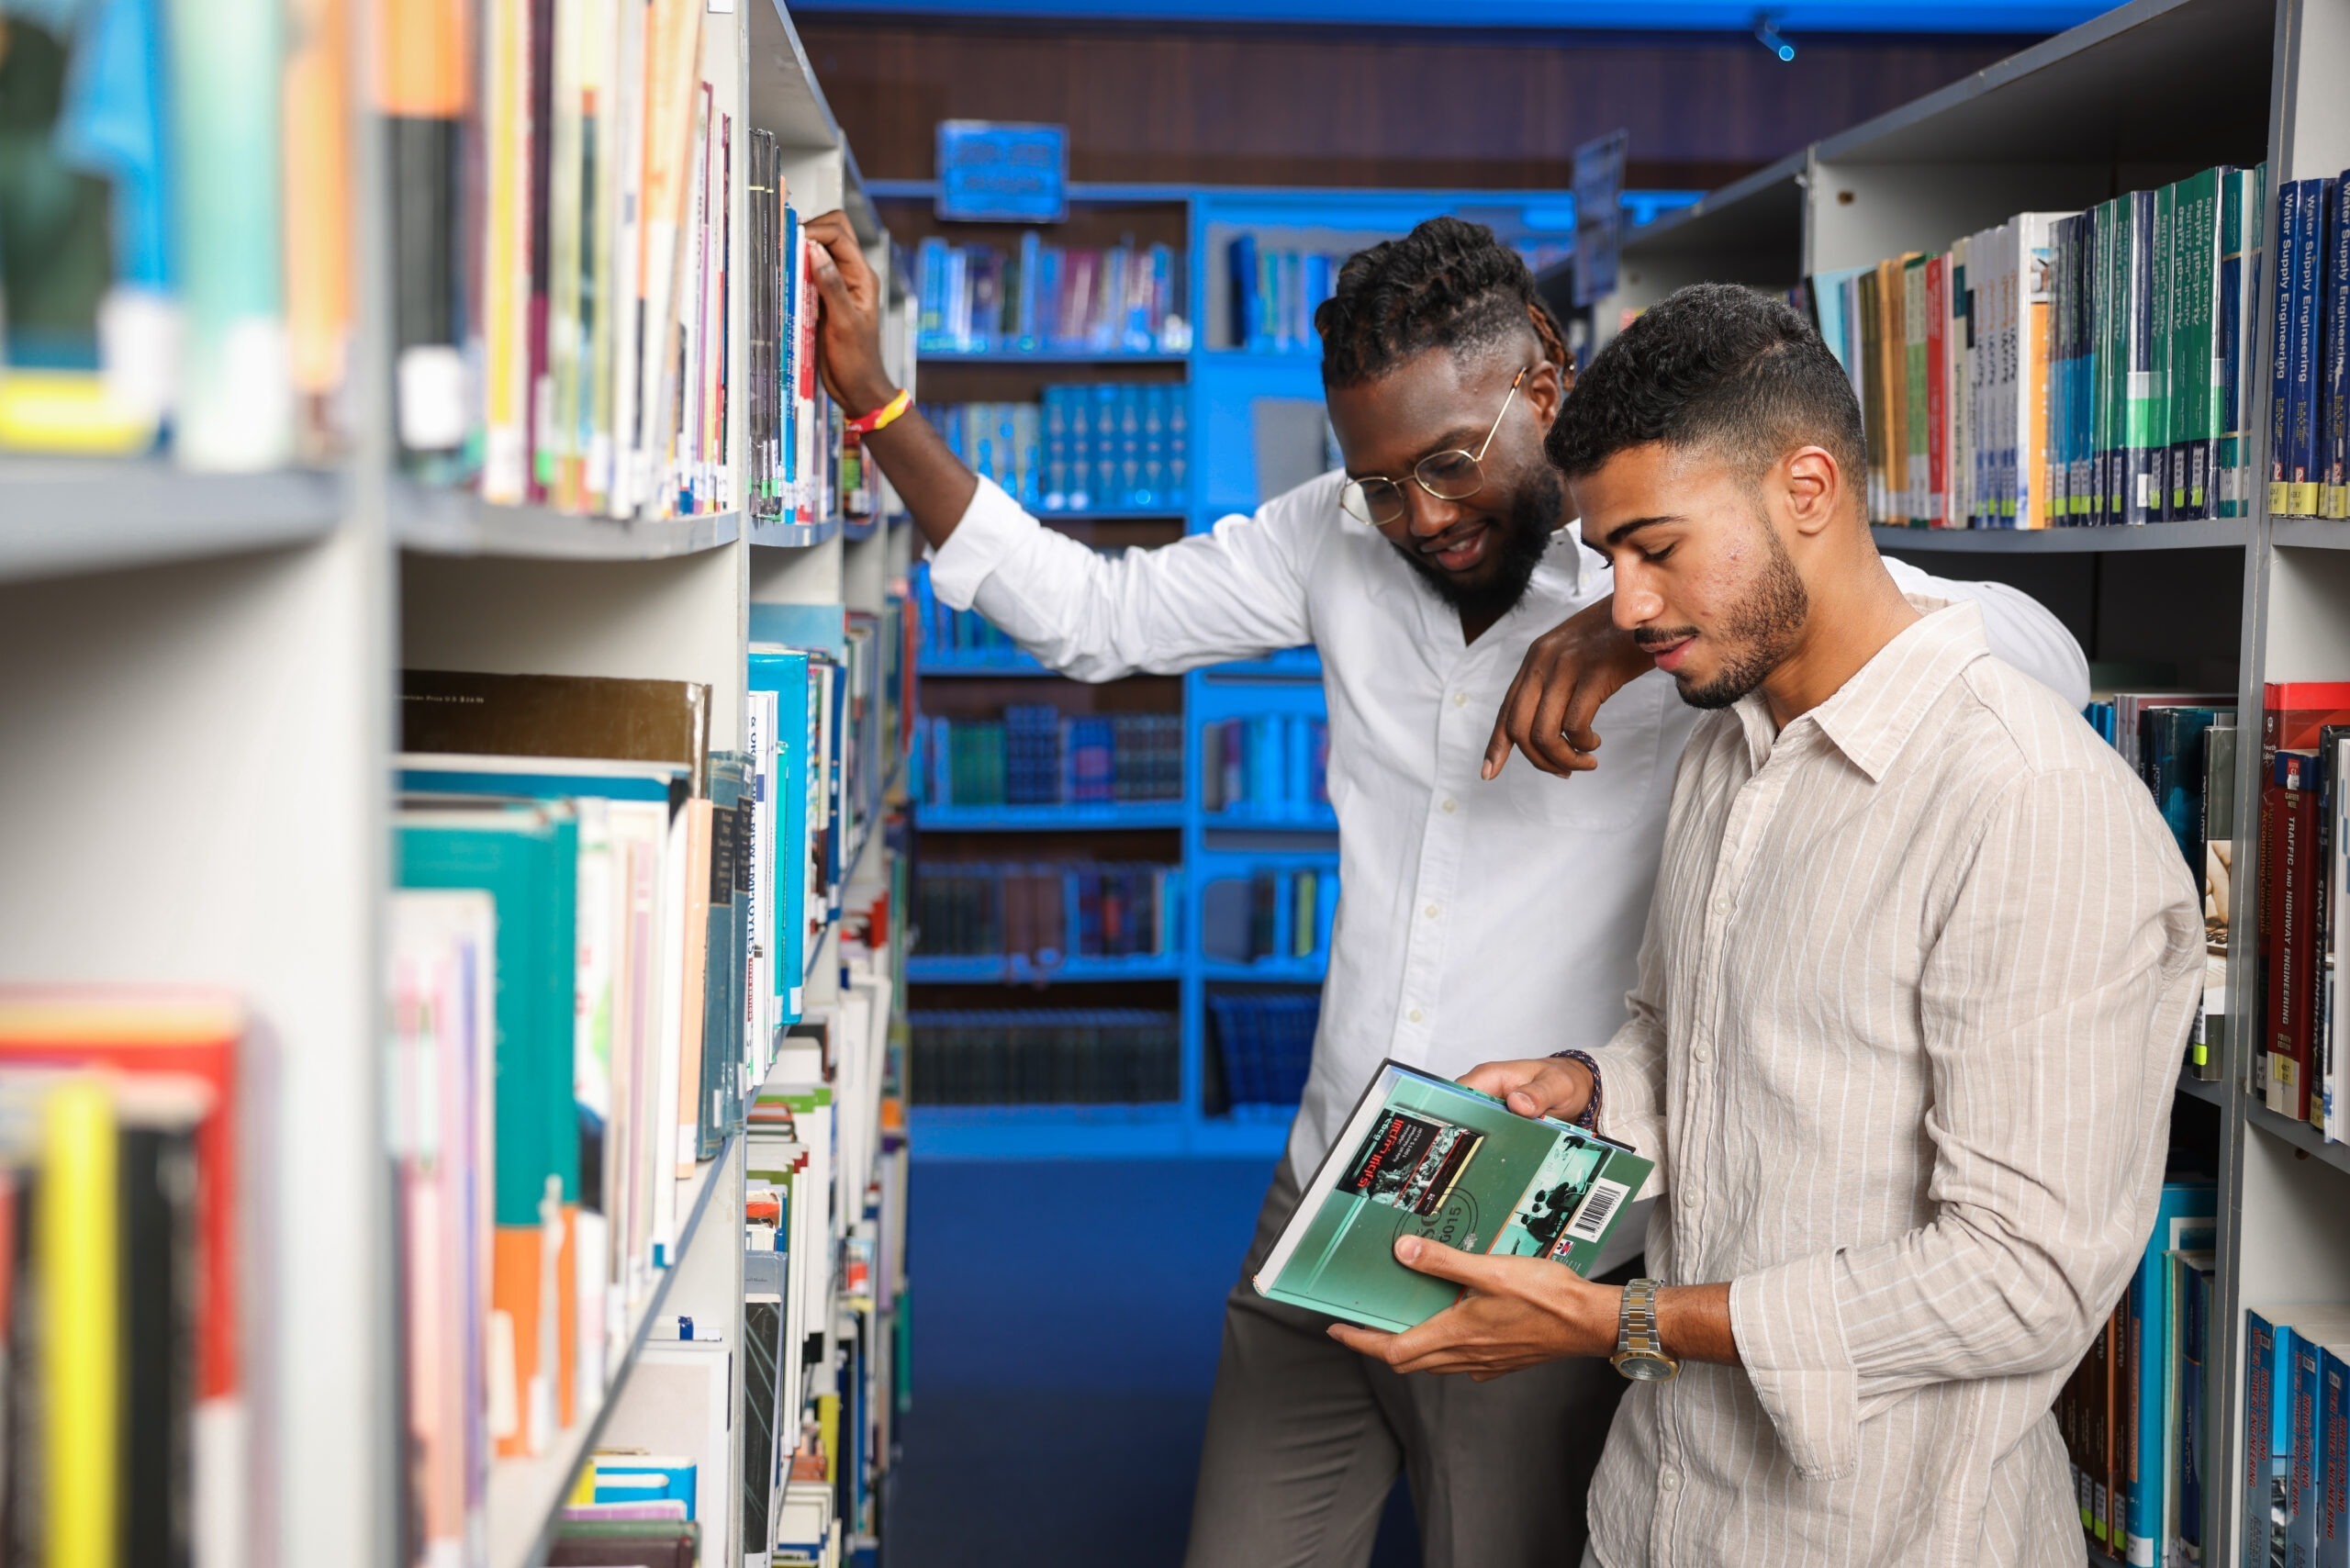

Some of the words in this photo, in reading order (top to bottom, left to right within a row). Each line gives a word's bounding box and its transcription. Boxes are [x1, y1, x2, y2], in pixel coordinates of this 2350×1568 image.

[2283, 194, 2293, 235] Water
[2306, 195, 2315, 236] Water
[2342, 182, 2350, 224] Water
[2280, 240, 2291, 288] Supply
[2302, 241, 2313, 290] Supply
[2339, 230, 2350, 280] Supply
[2192, 251, 2201, 326] المحاسبة
[2277, 293, 2289, 378] Engineering
[2299, 296, 2311, 382] Engineering
[2260, 810, 2268, 878] Accounting
[2287, 817, 2295, 866] TRAFFIC
[2259, 879, 2267, 934] Concepts
[2284, 889, 2293, 945] HIGHWAY
[2316, 879, 2324, 934] SPACE
[2282, 947, 2292, 1025] ENGINEERING
[2313, 938, 2323, 1056] TECHNOLOGY
[1373, 1118, 1392, 1141] جودة
[1380, 1119, 1404, 1154] التدريب
[1403, 1142, 1416, 1158] 10015
[1357, 1154, 1382, 1188] الإداري
[2252, 1327, 2261, 1366] WATER
[2251, 1369, 2260, 1407] POWER
[2260, 1367, 2269, 1435] IRRIGATION
[2248, 1409, 2258, 1489] ENGINEERING
[2259, 1437, 2268, 1462] AND
[2302, 1393, 2311, 1462] IRRIGATION
[2328, 1416, 2338, 1456] POWER
[2338, 1414, 2347, 1485] IRRIGATION
[2292, 1436, 2301, 1516] ENGINEERING
[2301, 1465, 2310, 1489] AND
[2327, 1458, 2337, 1540] ENGINEERING
[2337, 1487, 2346, 1513] AND
